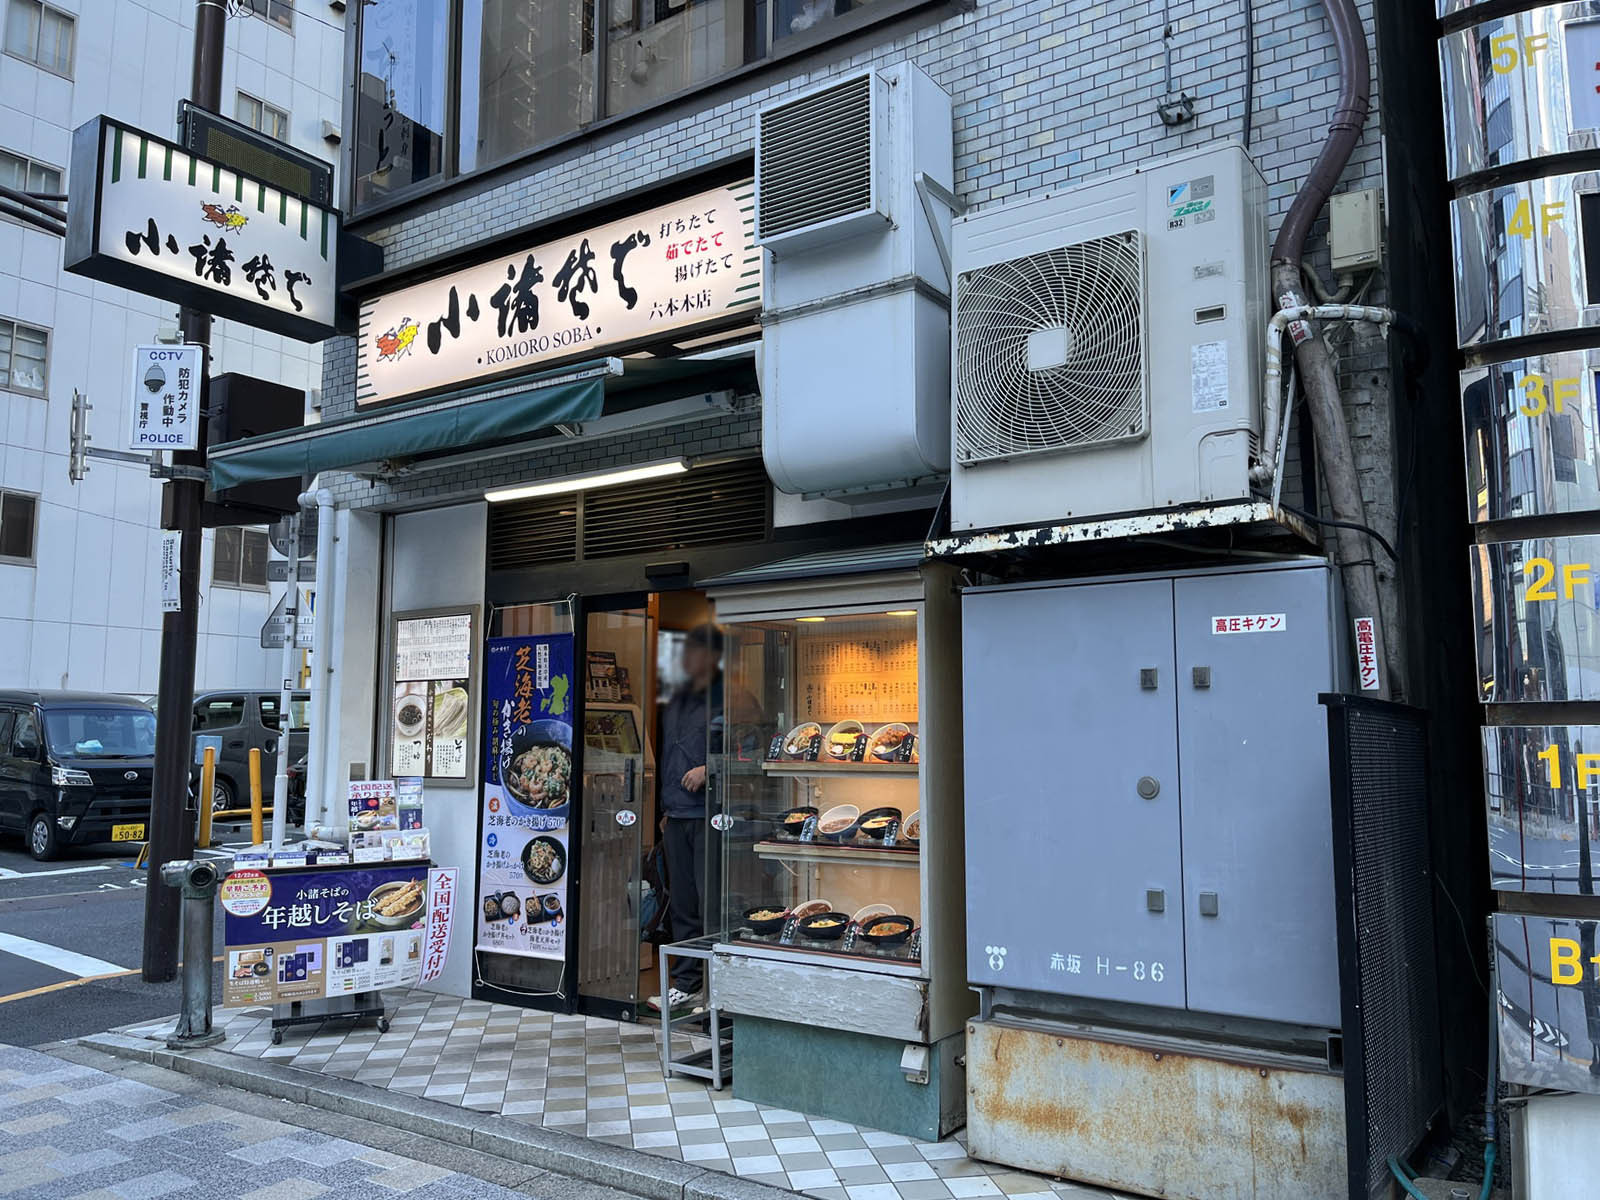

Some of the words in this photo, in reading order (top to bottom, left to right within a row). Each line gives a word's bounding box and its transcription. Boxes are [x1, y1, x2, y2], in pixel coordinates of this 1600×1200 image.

[1490, 32, 1549, 75] 5F
[659, 208, 717, 239] 打ちたて
[1507, 199, 1565, 240] 4F
[665, 231, 725, 261] 茹でたて
[674, 253, 733, 284] 揚げたて
[648, 289, 712, 321] 六本木店
[149, 351, 184, 362] CCTV
[486, 337, 550, 366] KOMORO
[553, 326, 593, 350] SOBA
[163, 393, 175, 428] 作動中
[178, 366, 191, 425] 防犯カメラ
[1519, 374, 1580, 417] 3F
[139, 402, 149, 429] 警視庁
[139, 433, 184, 444] POLICE
[1524, 557, 1590, 602] 2F
[1215, 616, 1281, 633] 高圧キケン
[1356, 619, 1376, 688] 高電圧キケン
[500, 699, 515, 769] かき揚げ
[350, 783, 392, 792] 全国配送
[296, 887, 349, 901] 小諸そばの
[262, 898, 378, 931] 年越しそば
[424, 872, 452, 982] 全国配送受付中
[1050, 952, 1081, 974] 赤坂
[1096, 956, 1165, 983] H-86
